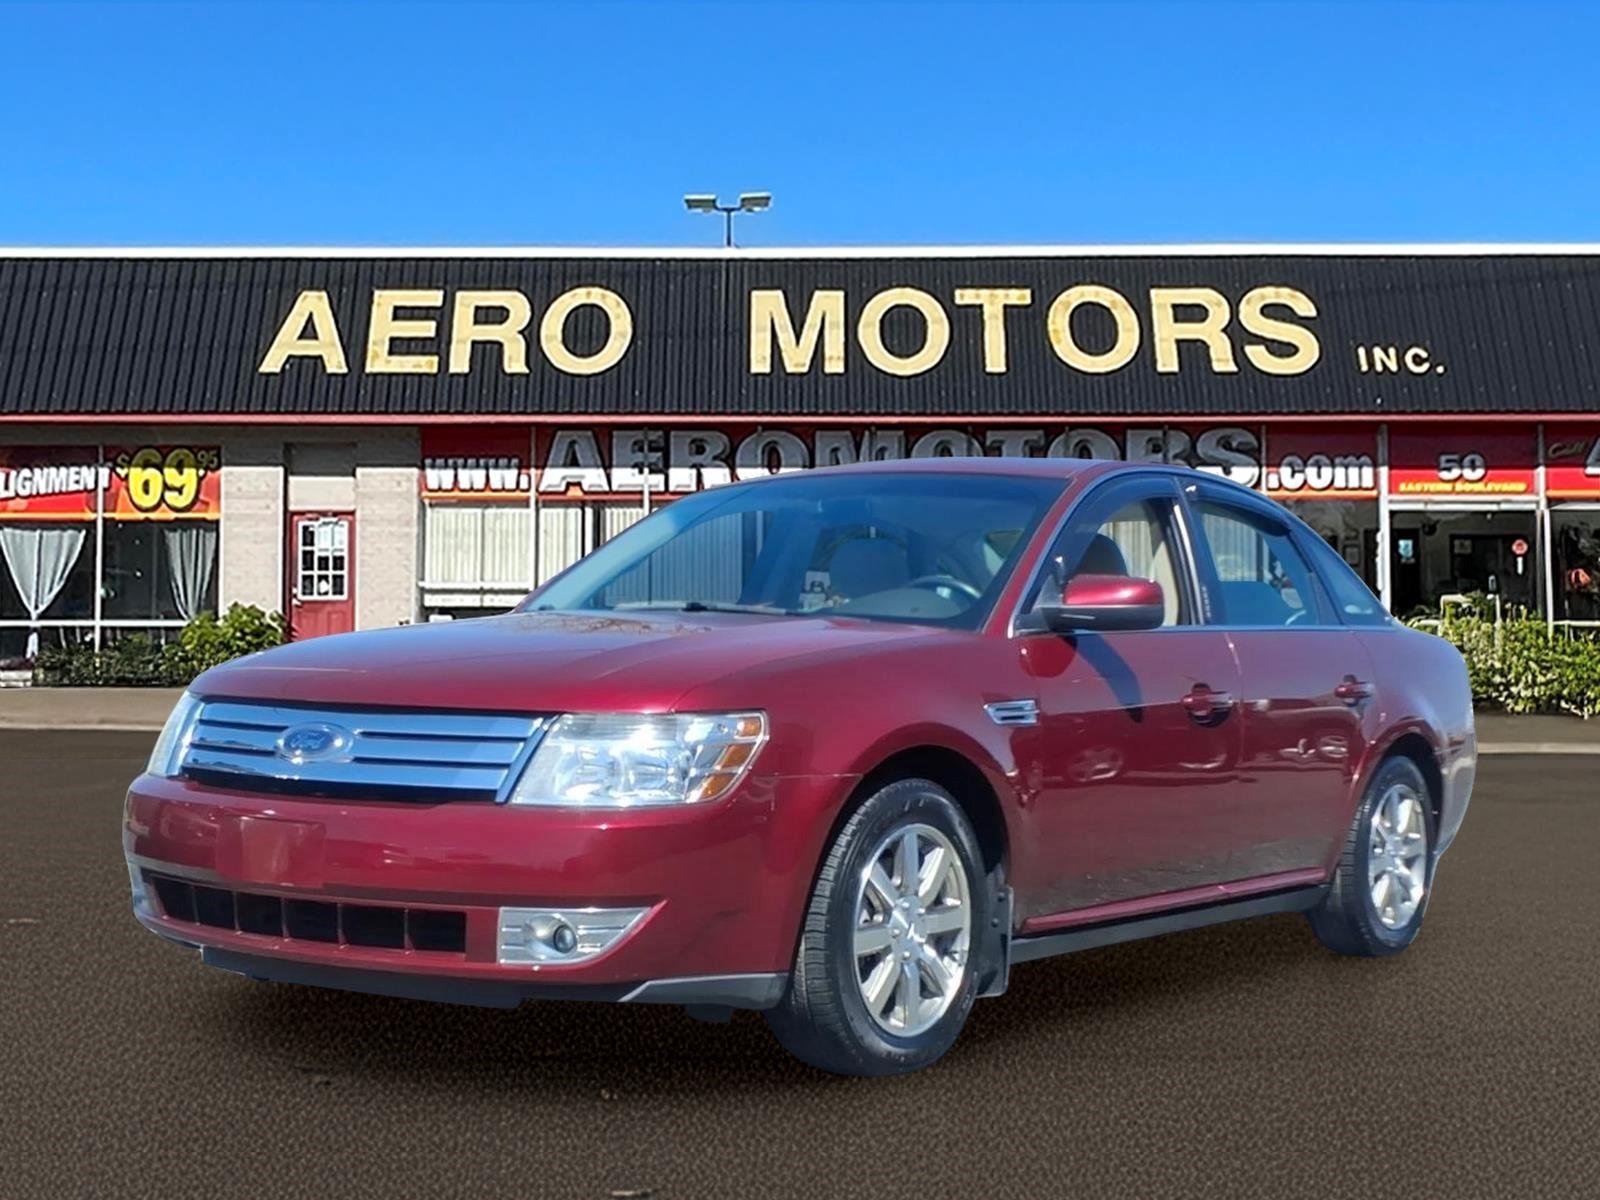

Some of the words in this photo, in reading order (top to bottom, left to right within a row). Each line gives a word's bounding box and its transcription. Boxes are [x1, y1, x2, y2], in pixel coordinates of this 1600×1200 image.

[258, 286, 633, 376] AERO
[749, 285, 1320, 377] MOTORS
[1356, 346, 1447, 375] INC.
[1437, 454, 1486, 481] 50
